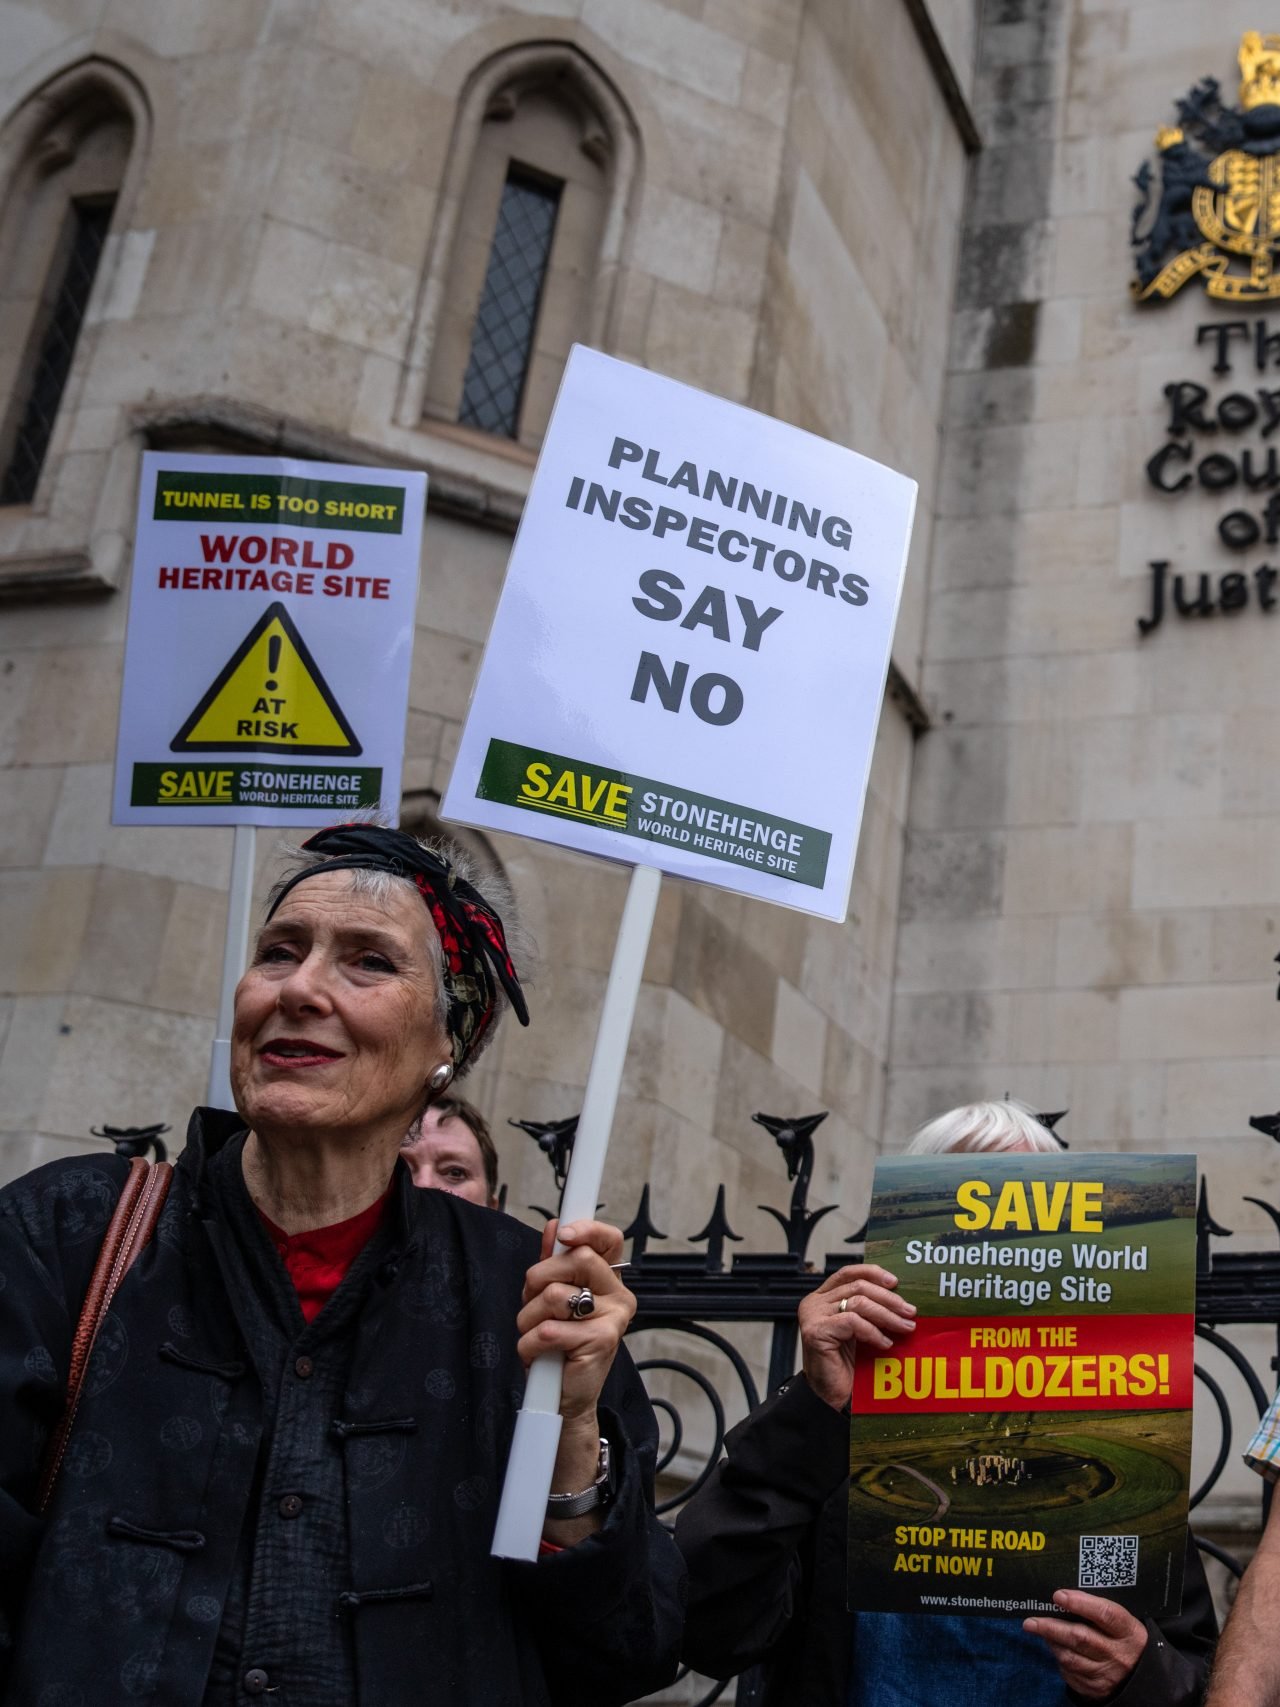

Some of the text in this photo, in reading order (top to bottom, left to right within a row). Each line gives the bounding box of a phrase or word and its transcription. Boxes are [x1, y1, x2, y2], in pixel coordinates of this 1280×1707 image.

[163, 491, 397, 520] TUNNEL IS TOO SHORT
[607, 436, 853, 551] PLANNING
[200, 535, 354, 570] WORLD
[565, 476, 870, 607] INSPECTORS
[158, 567, 391, 600] HERITAGE SITE
[631, 569, 784, 652] SAY
[630, 650, 745, 727] NO
[252, 698, 286, 714] AT
[236, 720, 299, 739] RISK
[160, 771, 362, 798] SAVE STONEHENGE
[239, 791, 359, 805] WORLD HERITAGE SITE
[521, 761, 804, 855] SAVE STONEHENGE
[637, 818, 798, 874] WORLD HERITAGE SITE
[954, 1180, 1104, 1234] SAVE
[905, 1240, 1148, 1272] Stonehenge World
[939, 1272, 1112, 1306] Heritage Site
[970, 1326, 1078, 1348] FROM THE
[874, 1354, 1170, 1400] BULLDOZERS!
[894, 1526, 1046, 1551] STOP THE ROAD
[894, 1554, 934, 1575] ACT
[936, 1556, 980, 1576] NOW
